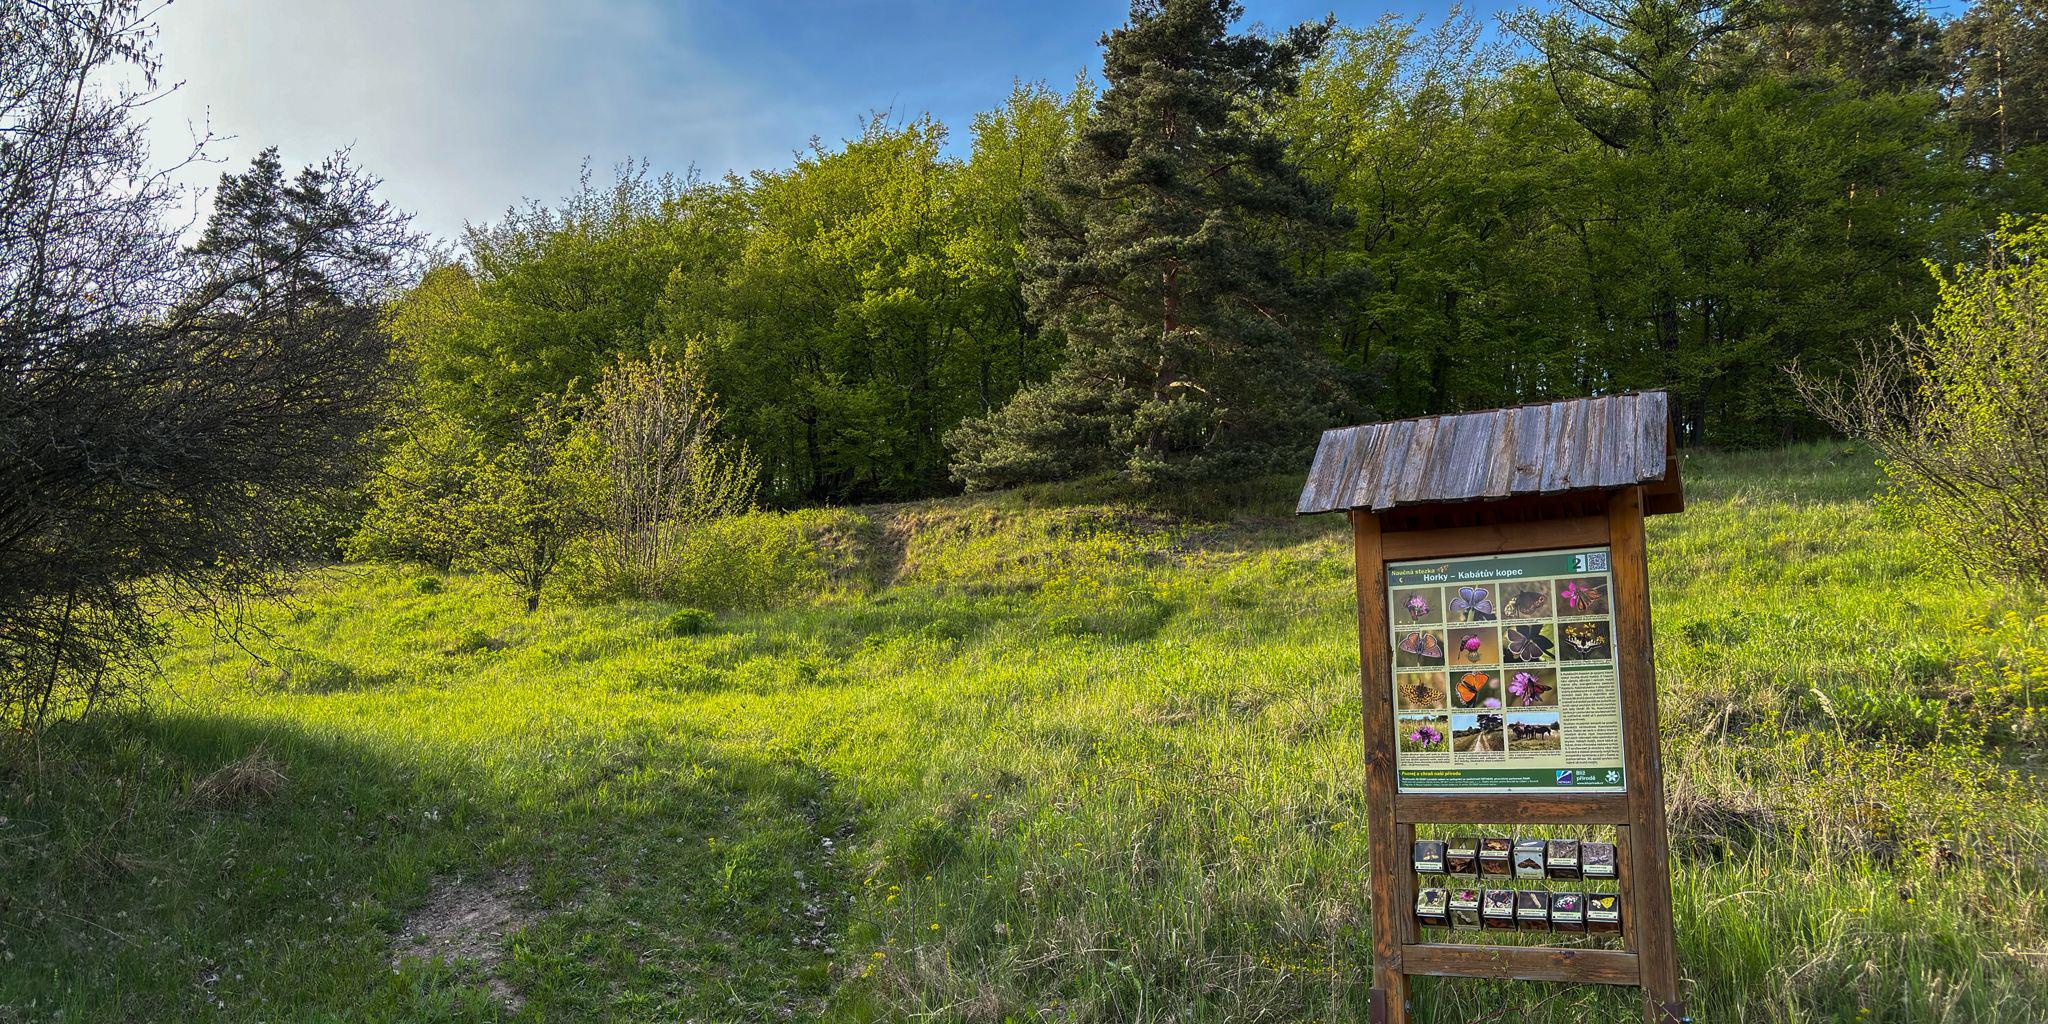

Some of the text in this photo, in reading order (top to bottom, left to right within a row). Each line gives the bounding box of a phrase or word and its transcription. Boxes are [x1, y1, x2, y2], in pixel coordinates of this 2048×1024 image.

[1572, 558, 1581, 569] 2
[1423, 573, 1448, 582] Horky
[1458, 570, 1494, 579] Kabátův
[1496, 568, 1523, 578] kopec
